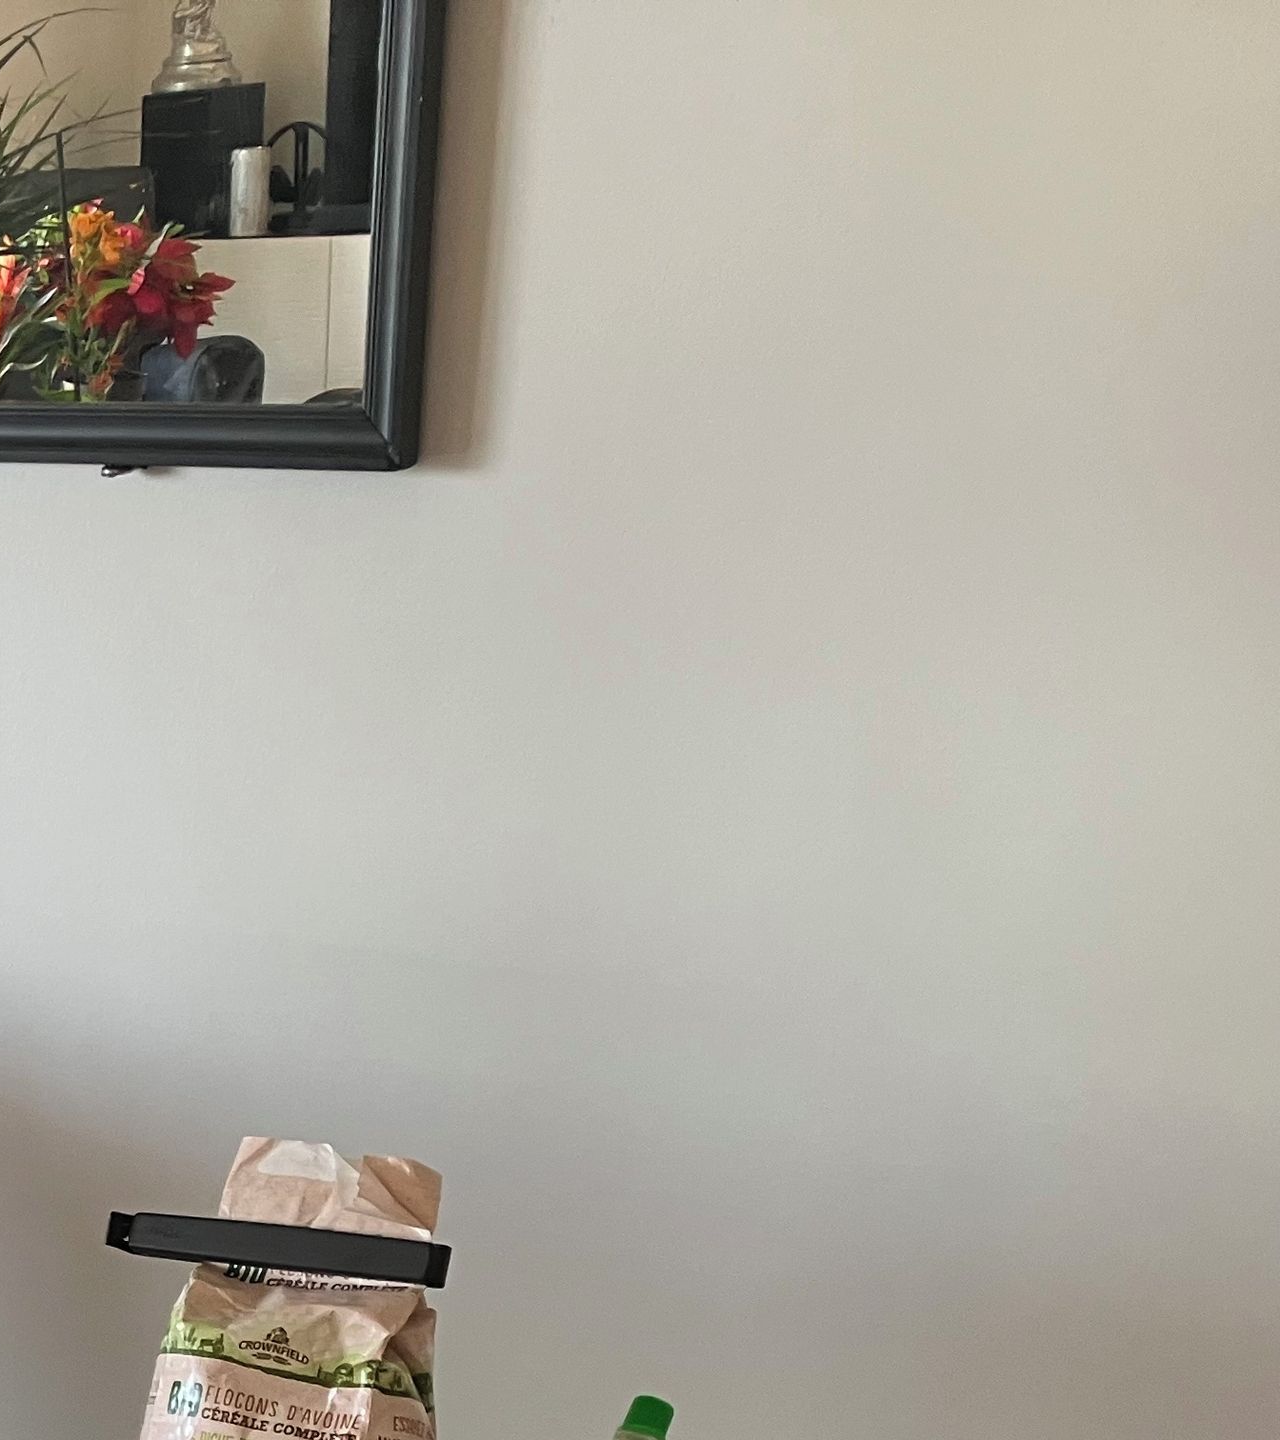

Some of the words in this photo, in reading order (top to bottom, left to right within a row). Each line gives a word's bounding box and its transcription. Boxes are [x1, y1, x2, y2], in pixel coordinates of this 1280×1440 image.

[239, 1340, 310, 1365] CROWNFIELD
[200, 1407, 269, 1432] CÉRÉALE
[204, 1384, 279, 1417] FLOCONS
[287, 1405, 361, 1430] D'AVOINE
